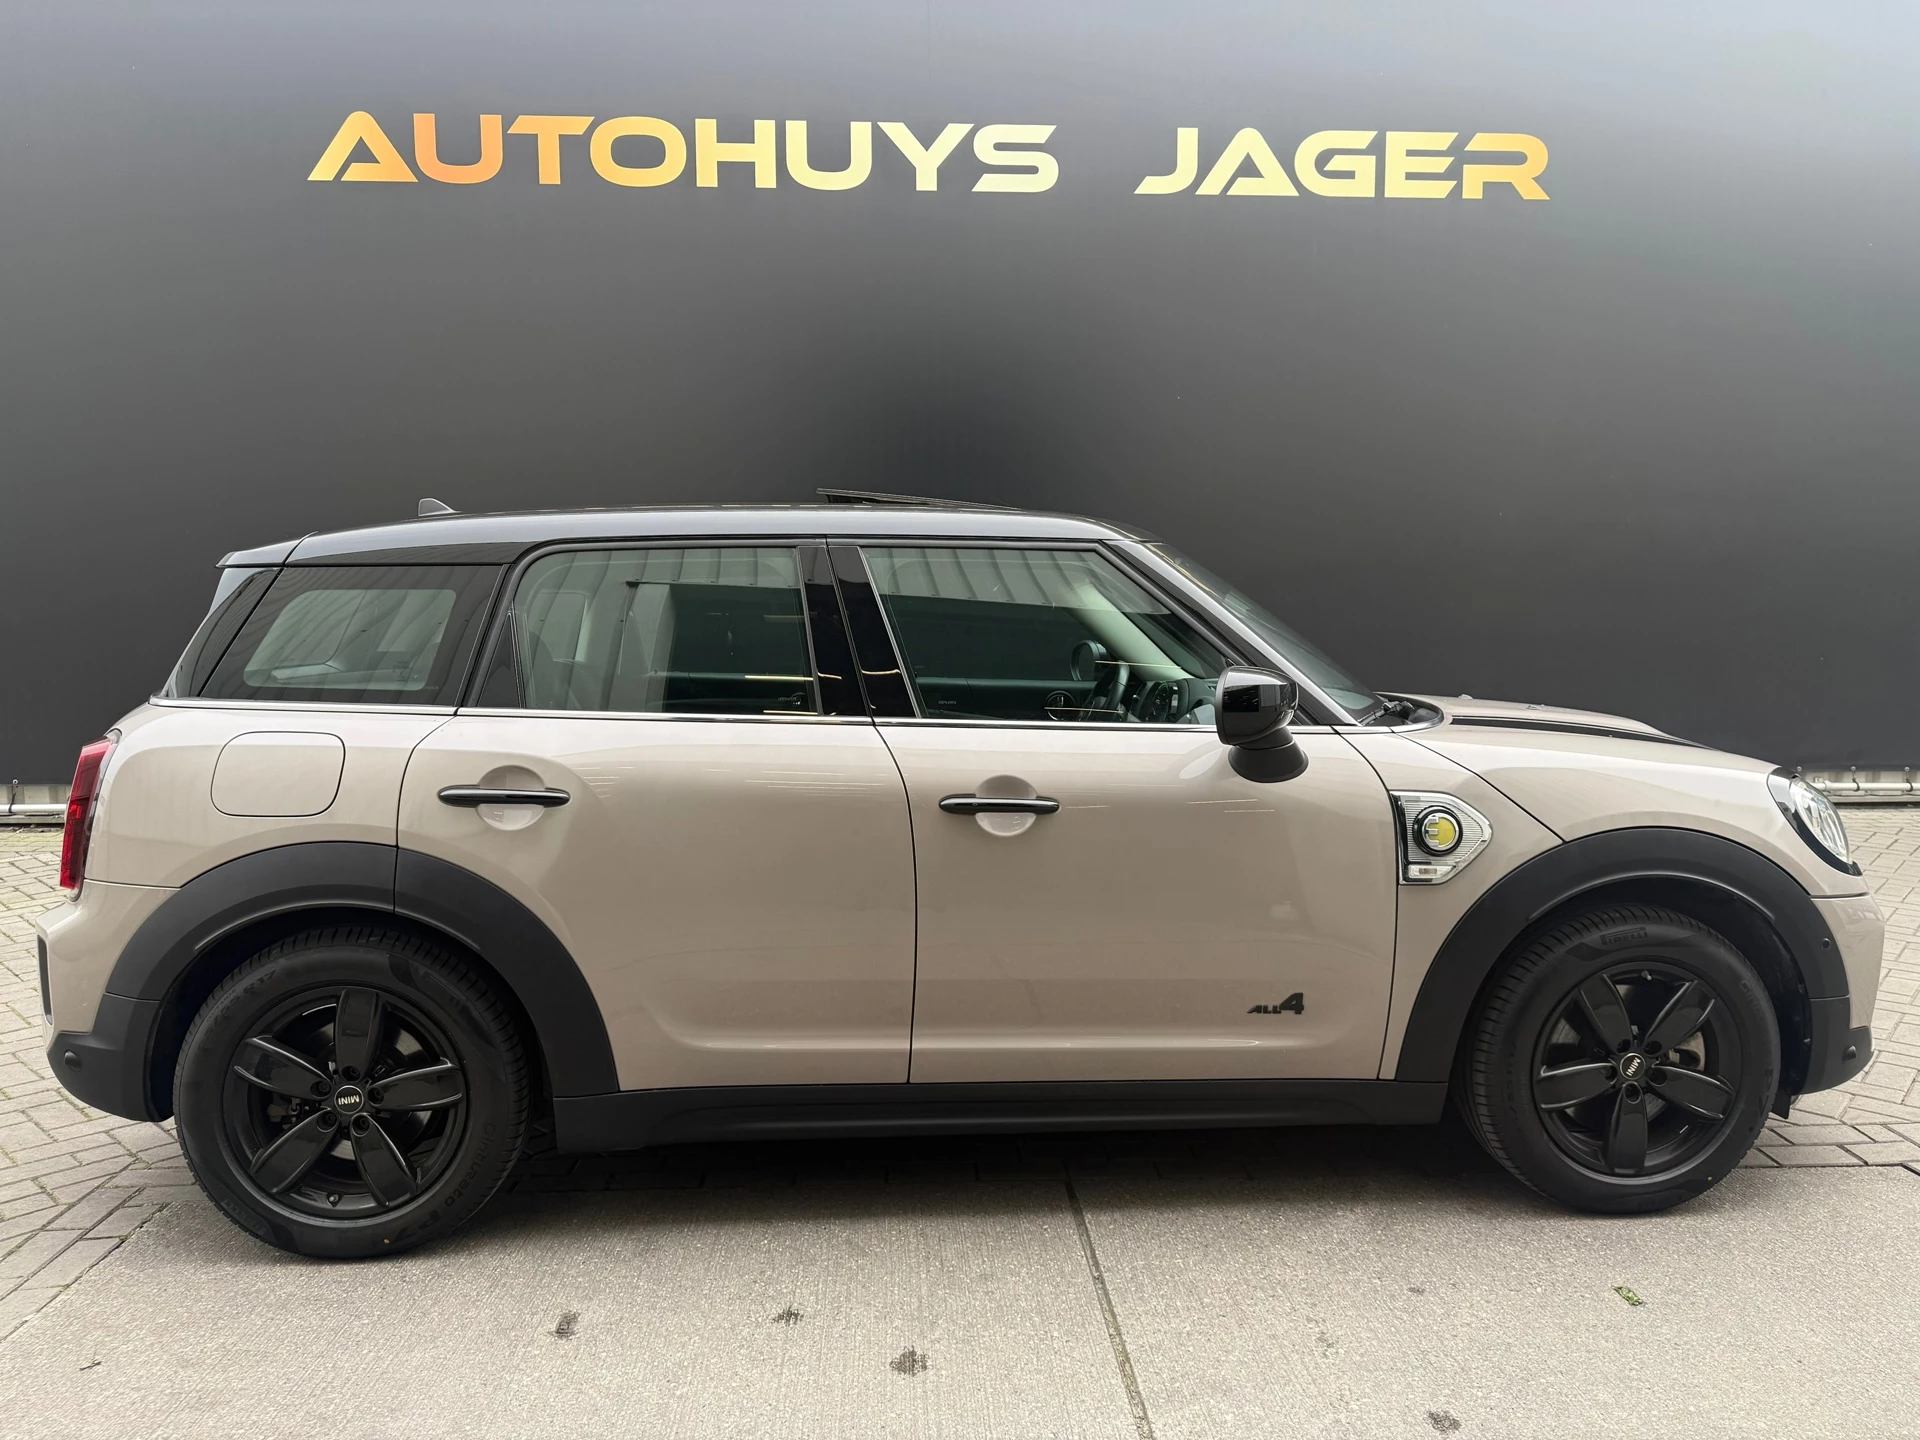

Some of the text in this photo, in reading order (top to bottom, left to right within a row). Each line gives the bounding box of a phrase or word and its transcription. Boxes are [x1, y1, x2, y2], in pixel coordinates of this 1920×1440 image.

[307, 111, 1550, 200] AUTOHUYS JAGER
[1246, 992, 1304, 1014] ALL4
[1625, 1057, 1641, 1076] MINI
[338, 1095, 360, 1105] MINI
